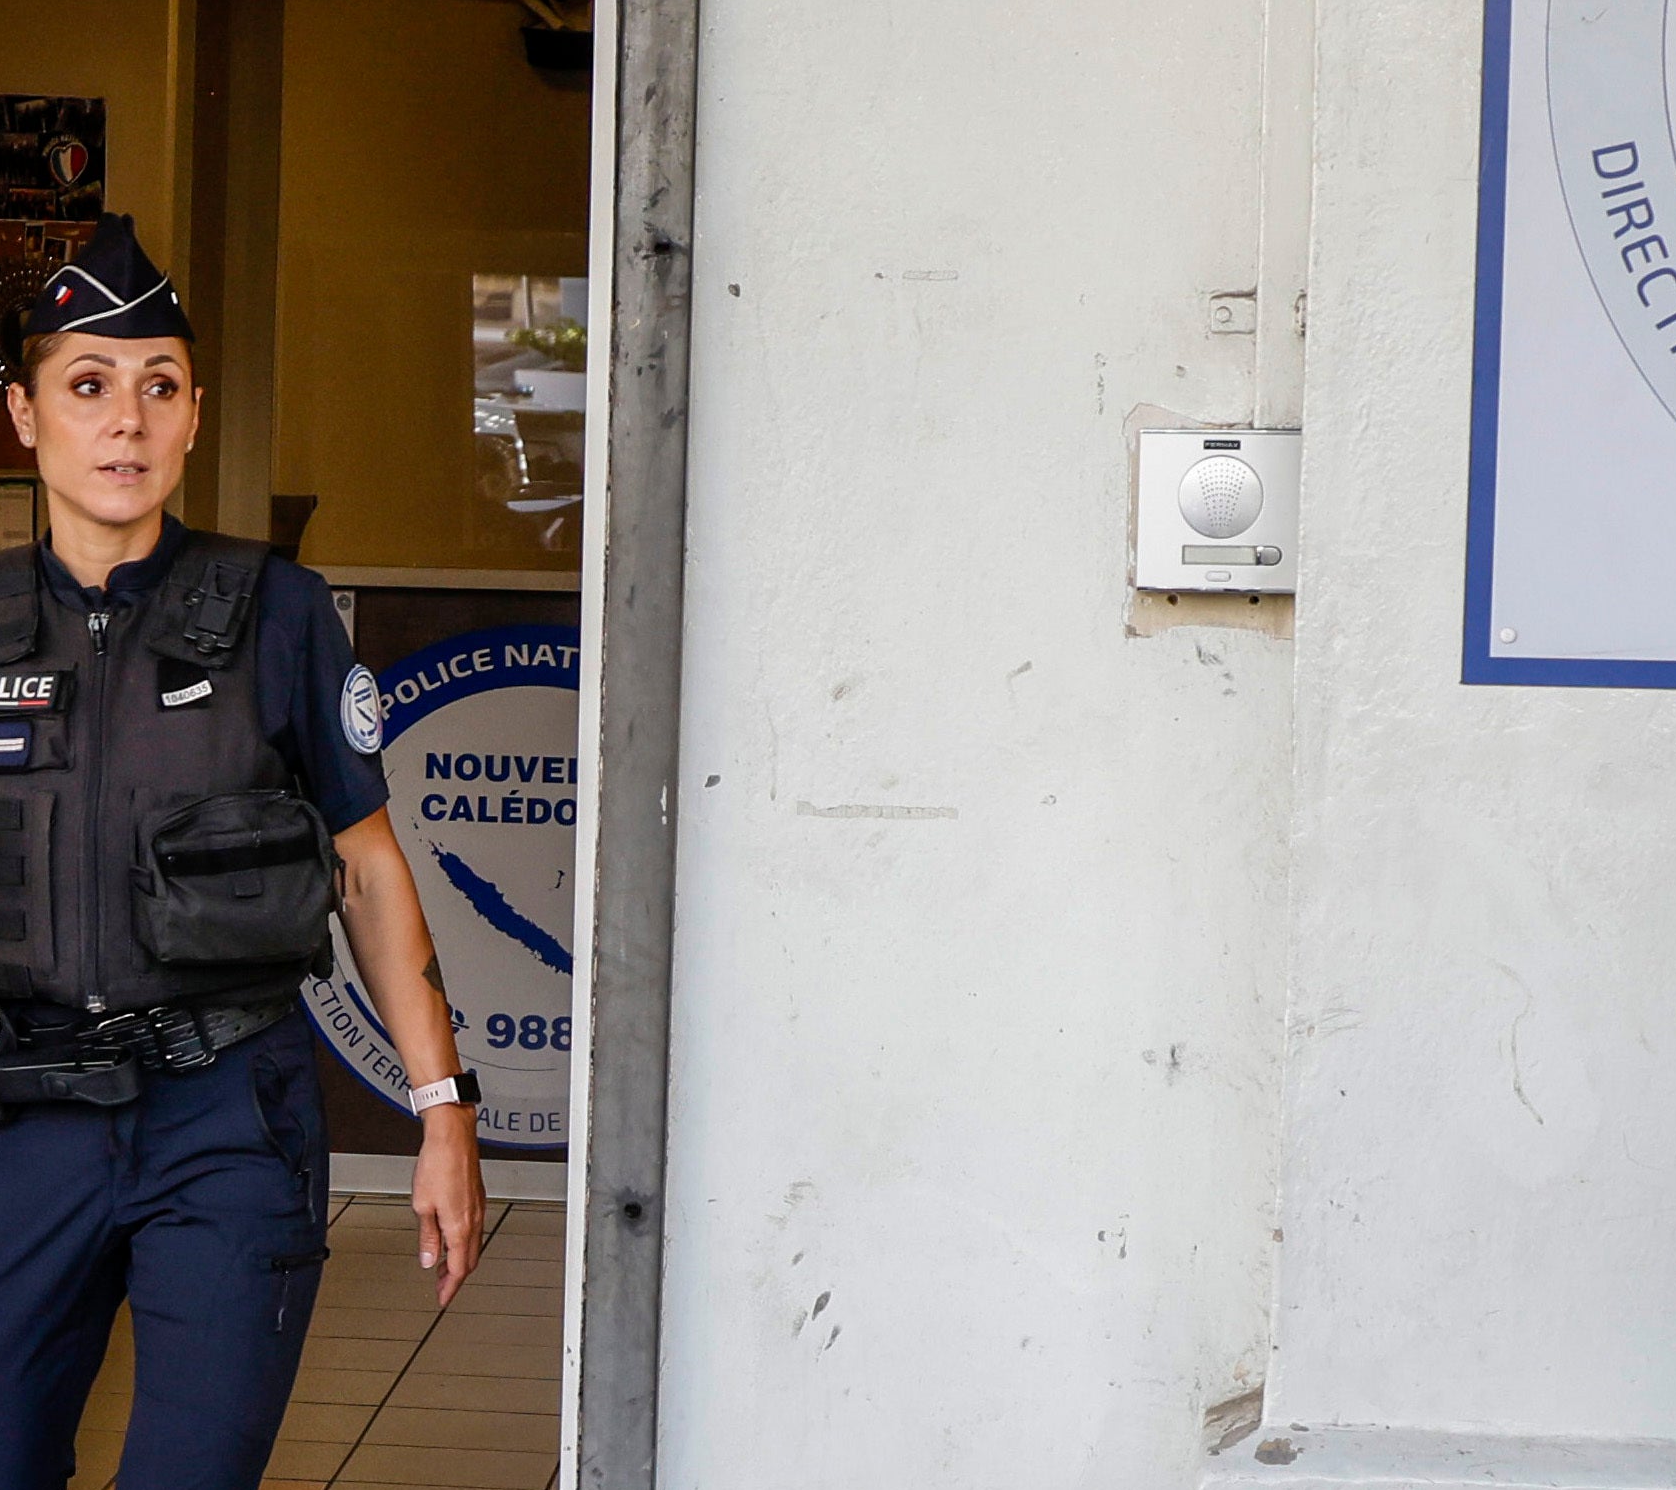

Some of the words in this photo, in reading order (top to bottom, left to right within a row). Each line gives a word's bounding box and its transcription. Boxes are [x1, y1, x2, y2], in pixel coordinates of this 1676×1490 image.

[380, 648, 495, 721] POLICE
[504, 644, 579, 669] NAT
[420, 789, 577, 827] CALÉDO
[486, 1013, 572, 1052] 988
[529, 1112, 562, 1133] DE
